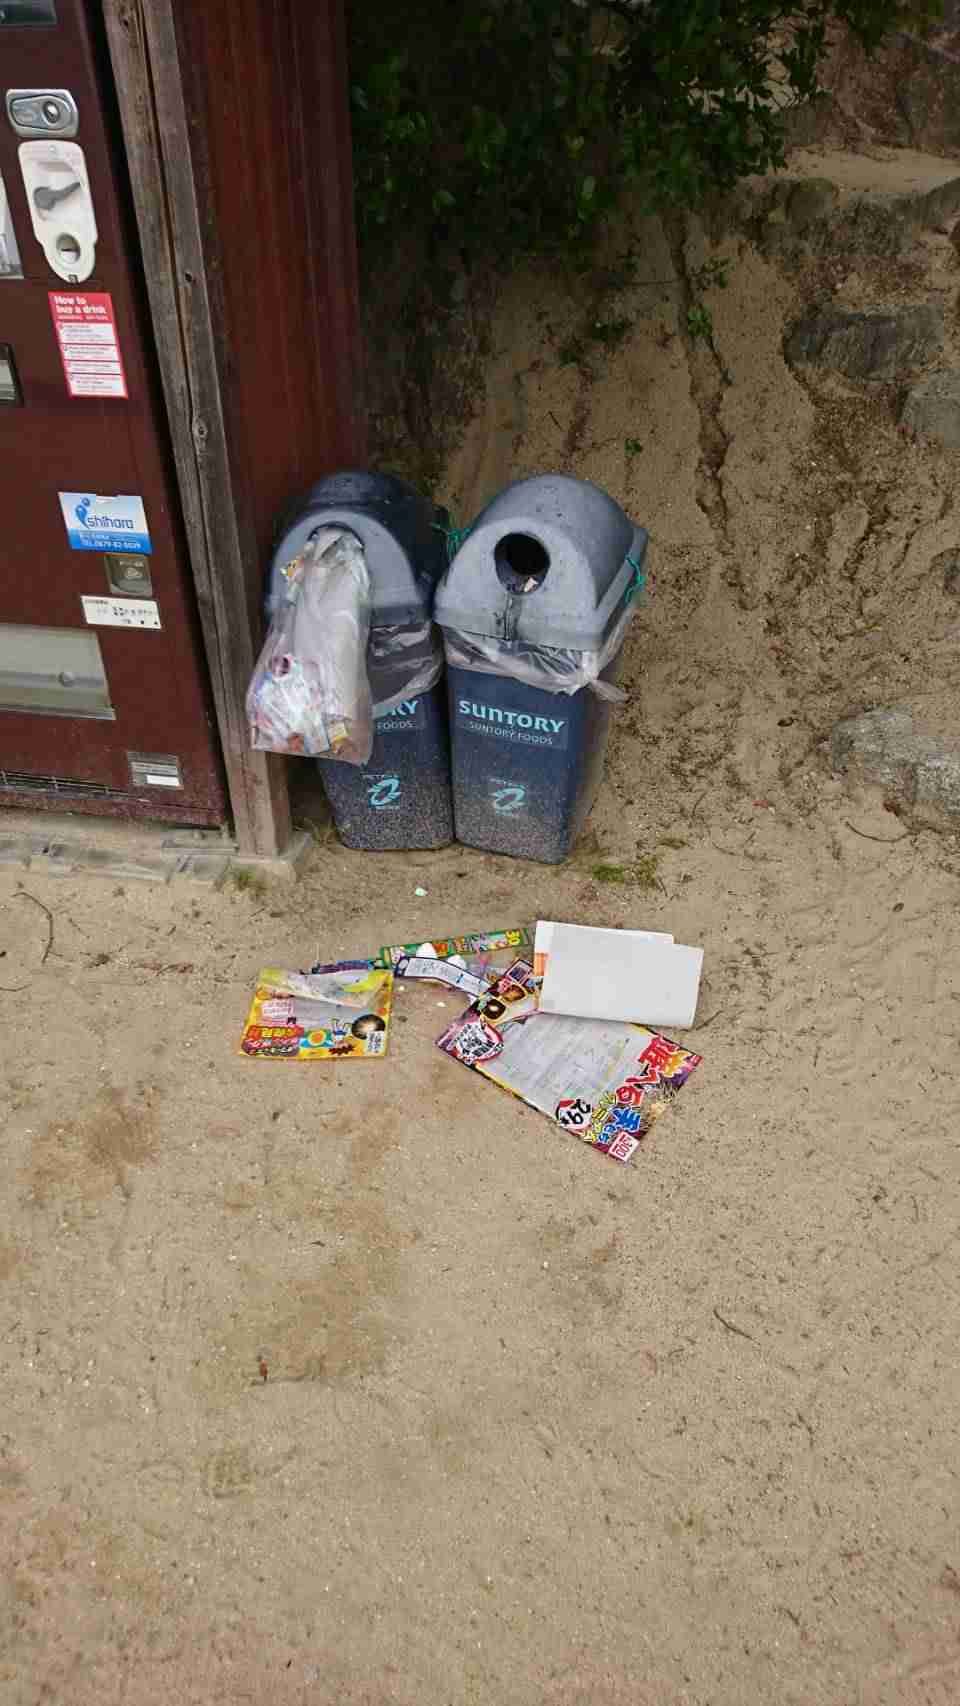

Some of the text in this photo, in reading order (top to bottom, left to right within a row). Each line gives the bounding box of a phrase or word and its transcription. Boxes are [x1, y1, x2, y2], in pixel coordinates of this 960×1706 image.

[459, 699, 565, 733] SUNTORY
[469, 720, 554, 745] SUNTORY FOODS
